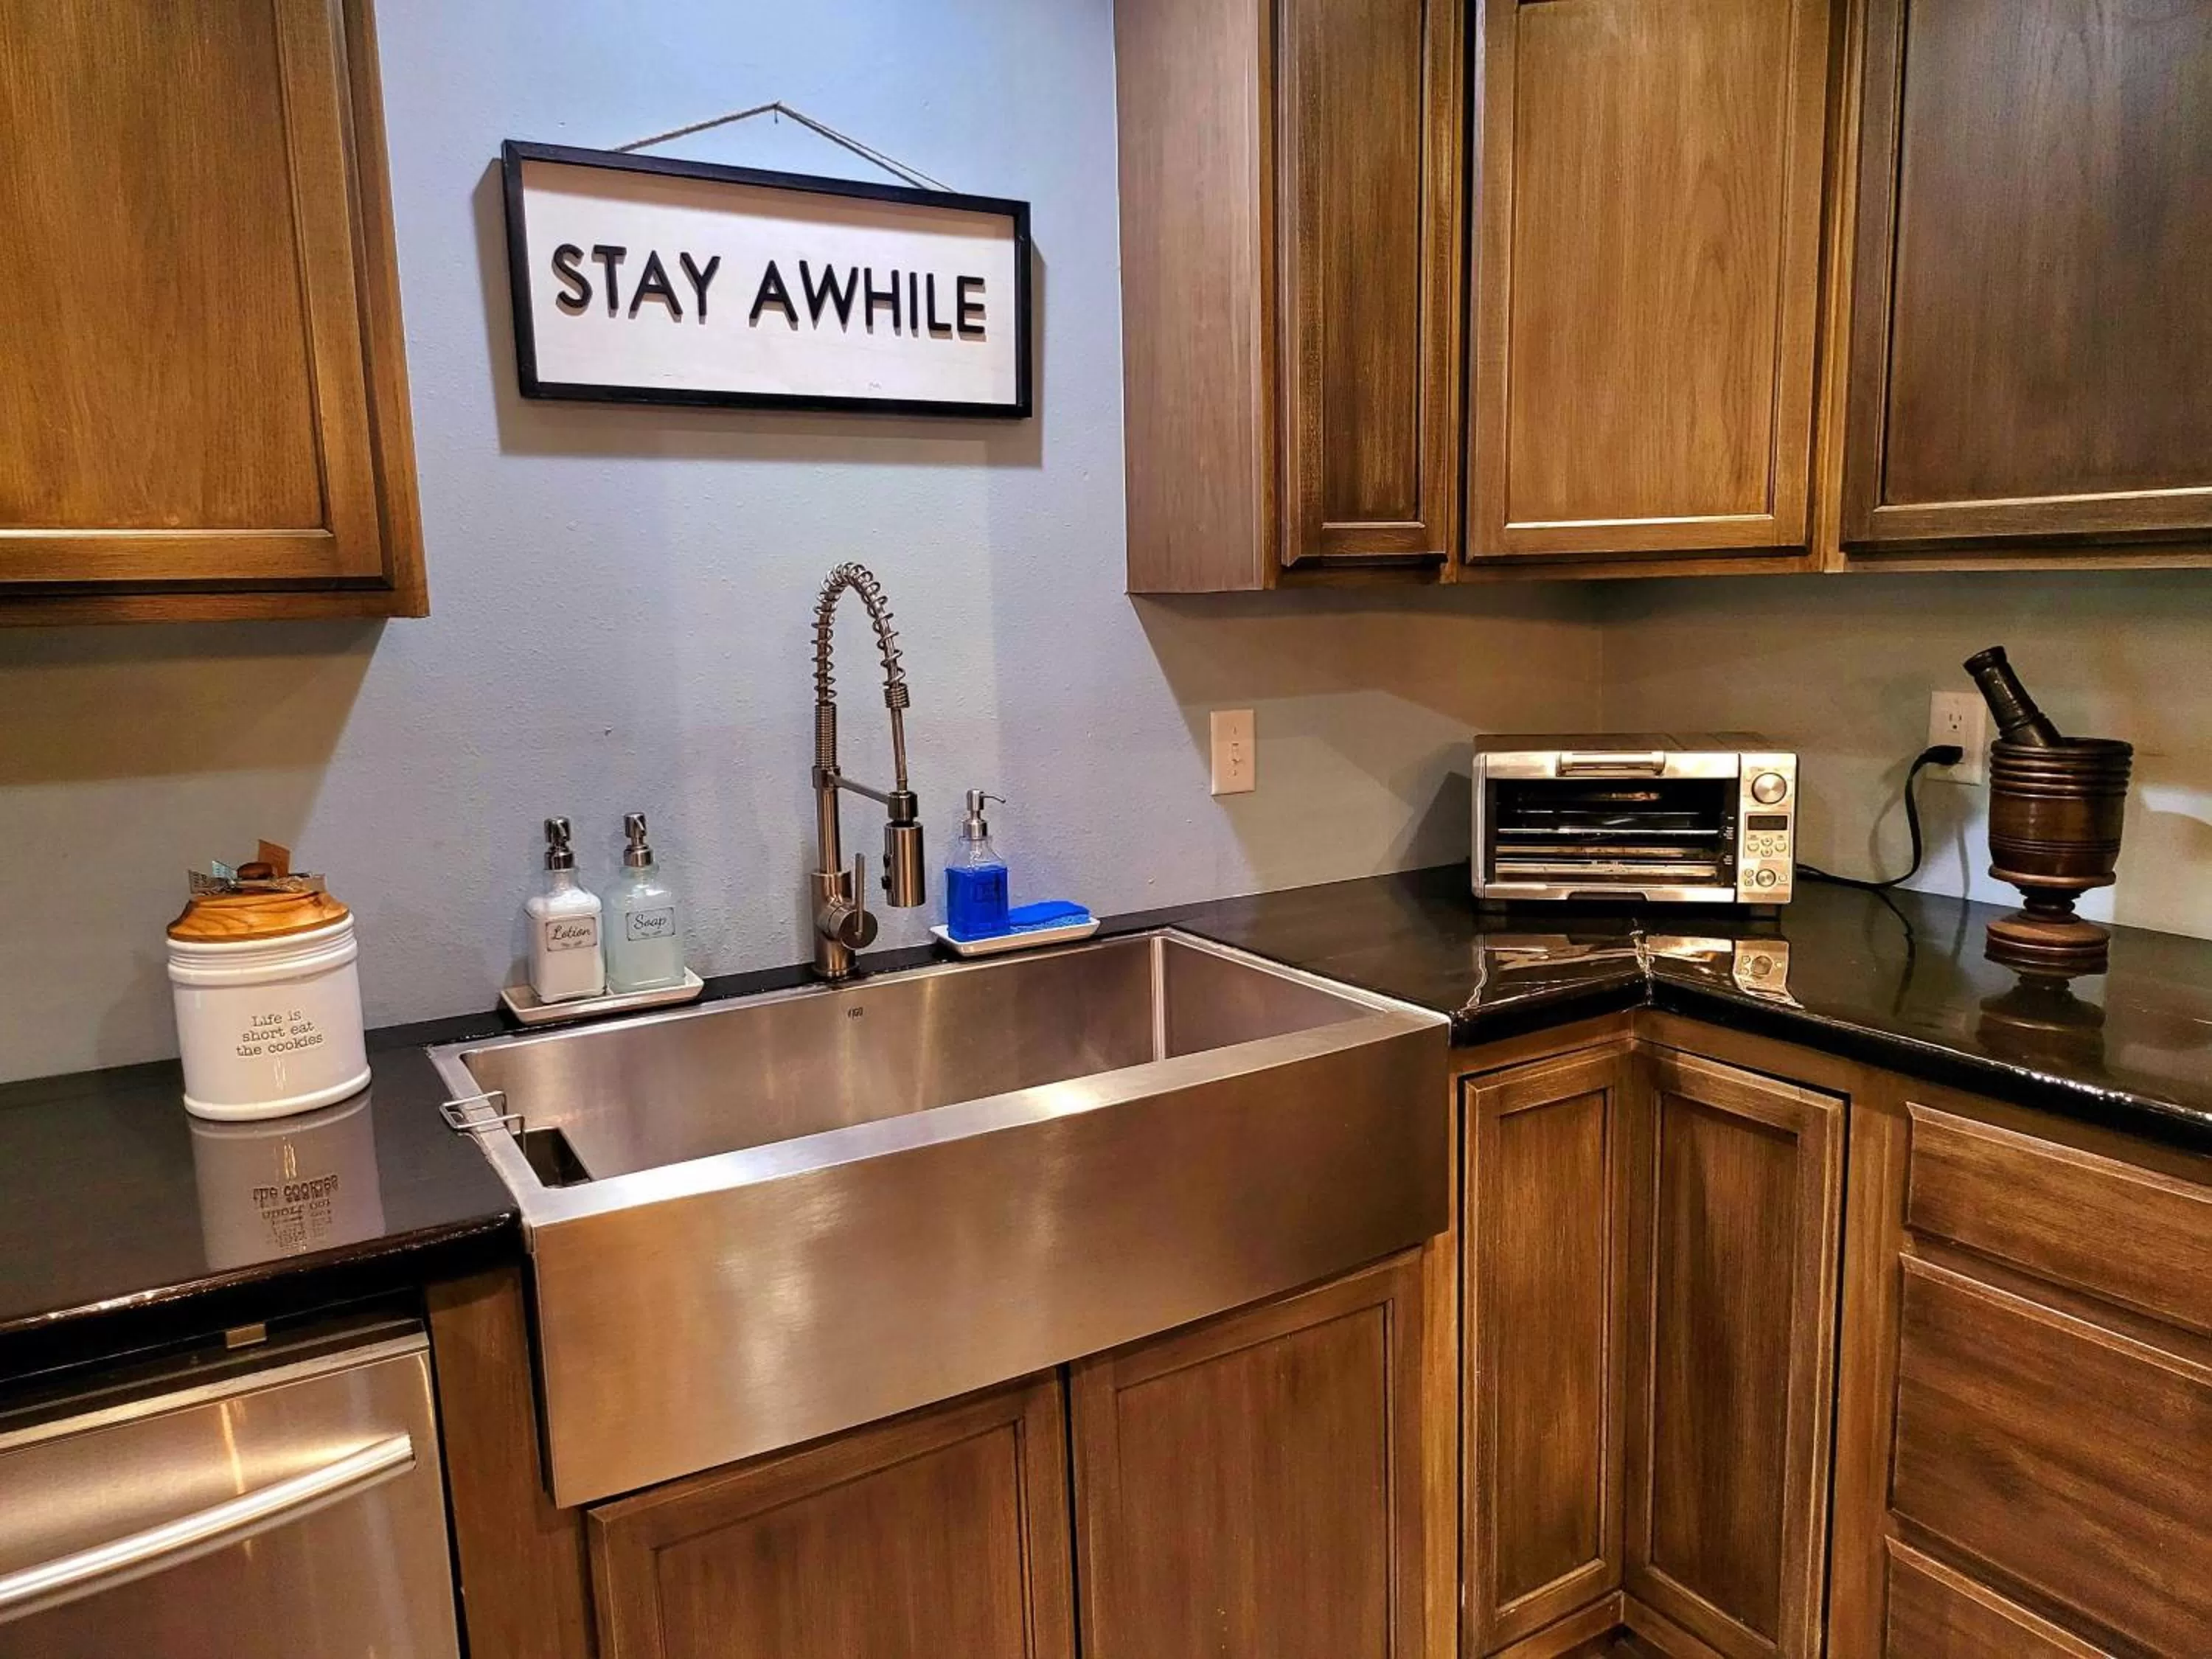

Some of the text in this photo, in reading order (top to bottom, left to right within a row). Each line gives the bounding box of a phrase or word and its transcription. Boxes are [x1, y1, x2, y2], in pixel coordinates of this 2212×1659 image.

[552, 244, 986, 335] STAY AWHILE
[633, 914, 667, 930] Soap
[552, 924, 591, 940] Lotion
[251, 1009, 302, 1027] Life is
[243, 1021, 315, 1042] short eat
[236, 1034, 324, 1057] the cookies
